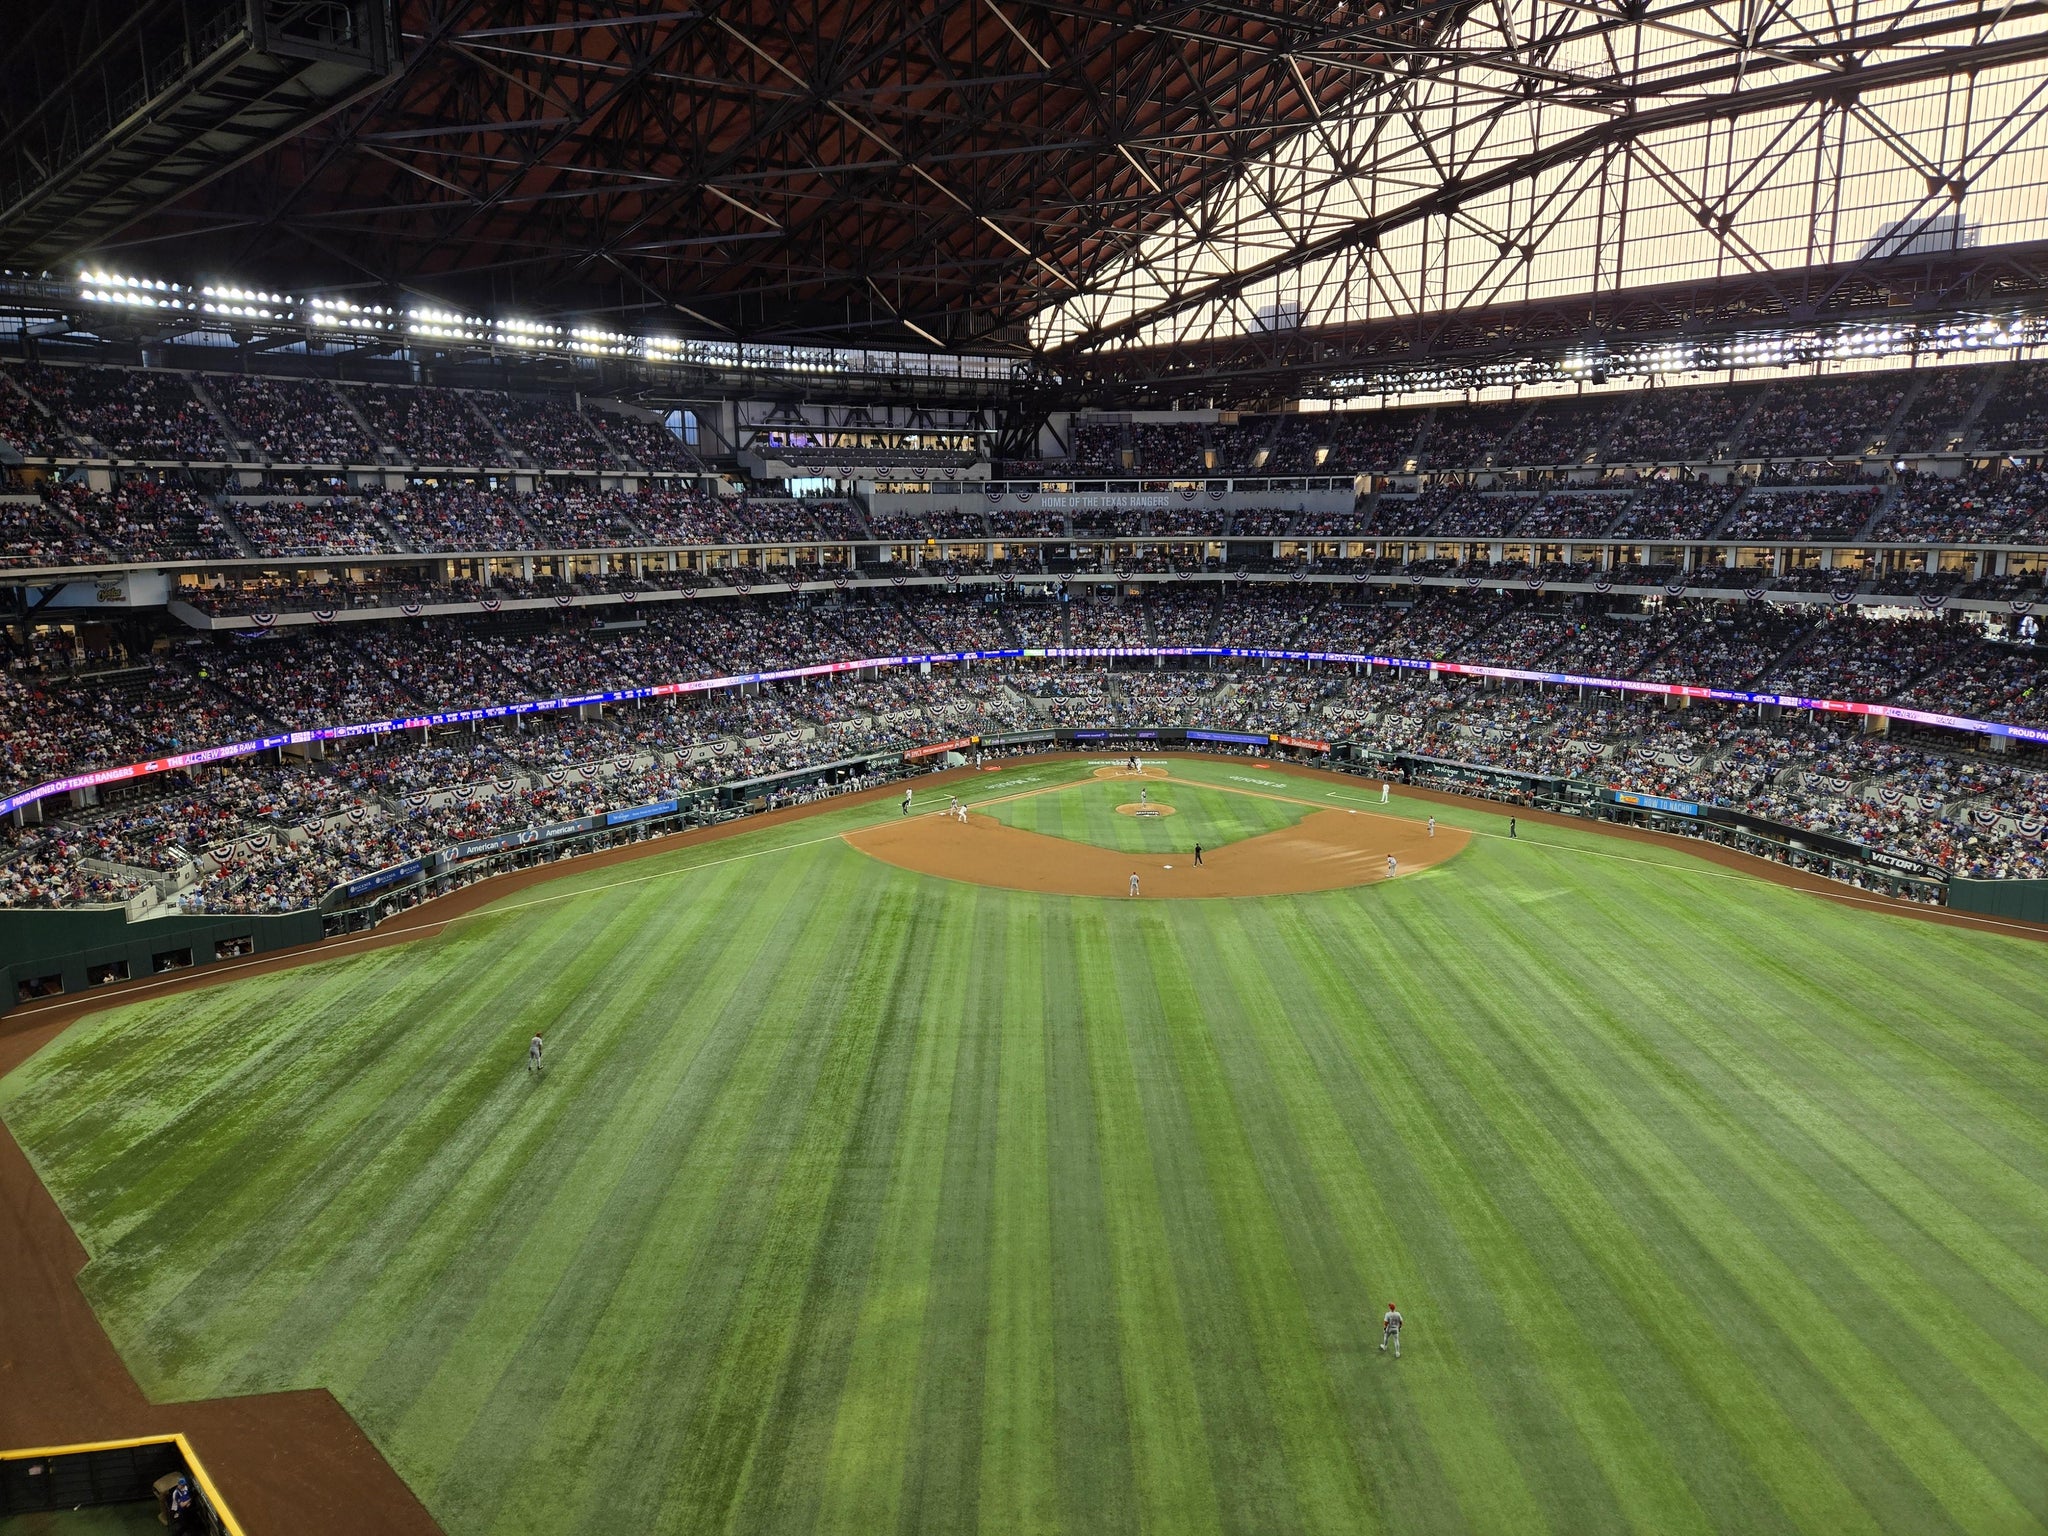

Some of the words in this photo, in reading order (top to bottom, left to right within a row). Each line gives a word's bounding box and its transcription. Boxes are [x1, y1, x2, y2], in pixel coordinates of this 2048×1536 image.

[1041, 497, 1066, 507] HOME
[1069, 497, 1080, 507] OF
[1082, 497, 1098, 506] THE
[1101, 497, 1127, 506] TEXAS
[1130, 496, 1169, 506] RANGERS
[1565, 675, 1585, 683] PROUD
[1586, 677, 1612, 686] PARTNER
[1621, 681, 1640, 689] TEXAS
[1641, 683, 1671, 692] RANGERS
[1867, 705, 1884, 714] THE
[1885, 708, 1917, 719] ALL-NEW
[2008, 727, 2035, 737] PROUD
[1291, 739, 1318, 749] Budweiser
[167, 756, 183, 767] THE
[184, 750, 218, 764] ALL-NEW
[220, 745, 238, 756] 2026
[239, 742, 256, 752] RAV4
[1441, 765, 1459, 777] Kroger
[1502, 776, 1522, 788] Kroger
[12, 793, 30, 807] PROUD
[30, 784, 55, 800] PARTNER
[56, 781, 67, 790] OF
[69, 775, 94, 788] TEXAS
[95, 767, 134, 782] RANGERS
[1644, 798, 1658, 808] HOW
[1660, 800, 1668, 809] TO
[1669, 802, 1692, 813] NACHO!
[467, 840, 499, 854] American
[517, 830, 539, 844] 100
[546, 825, 575, 837] American
[1872, 852, 1921, 871] VICTORY
